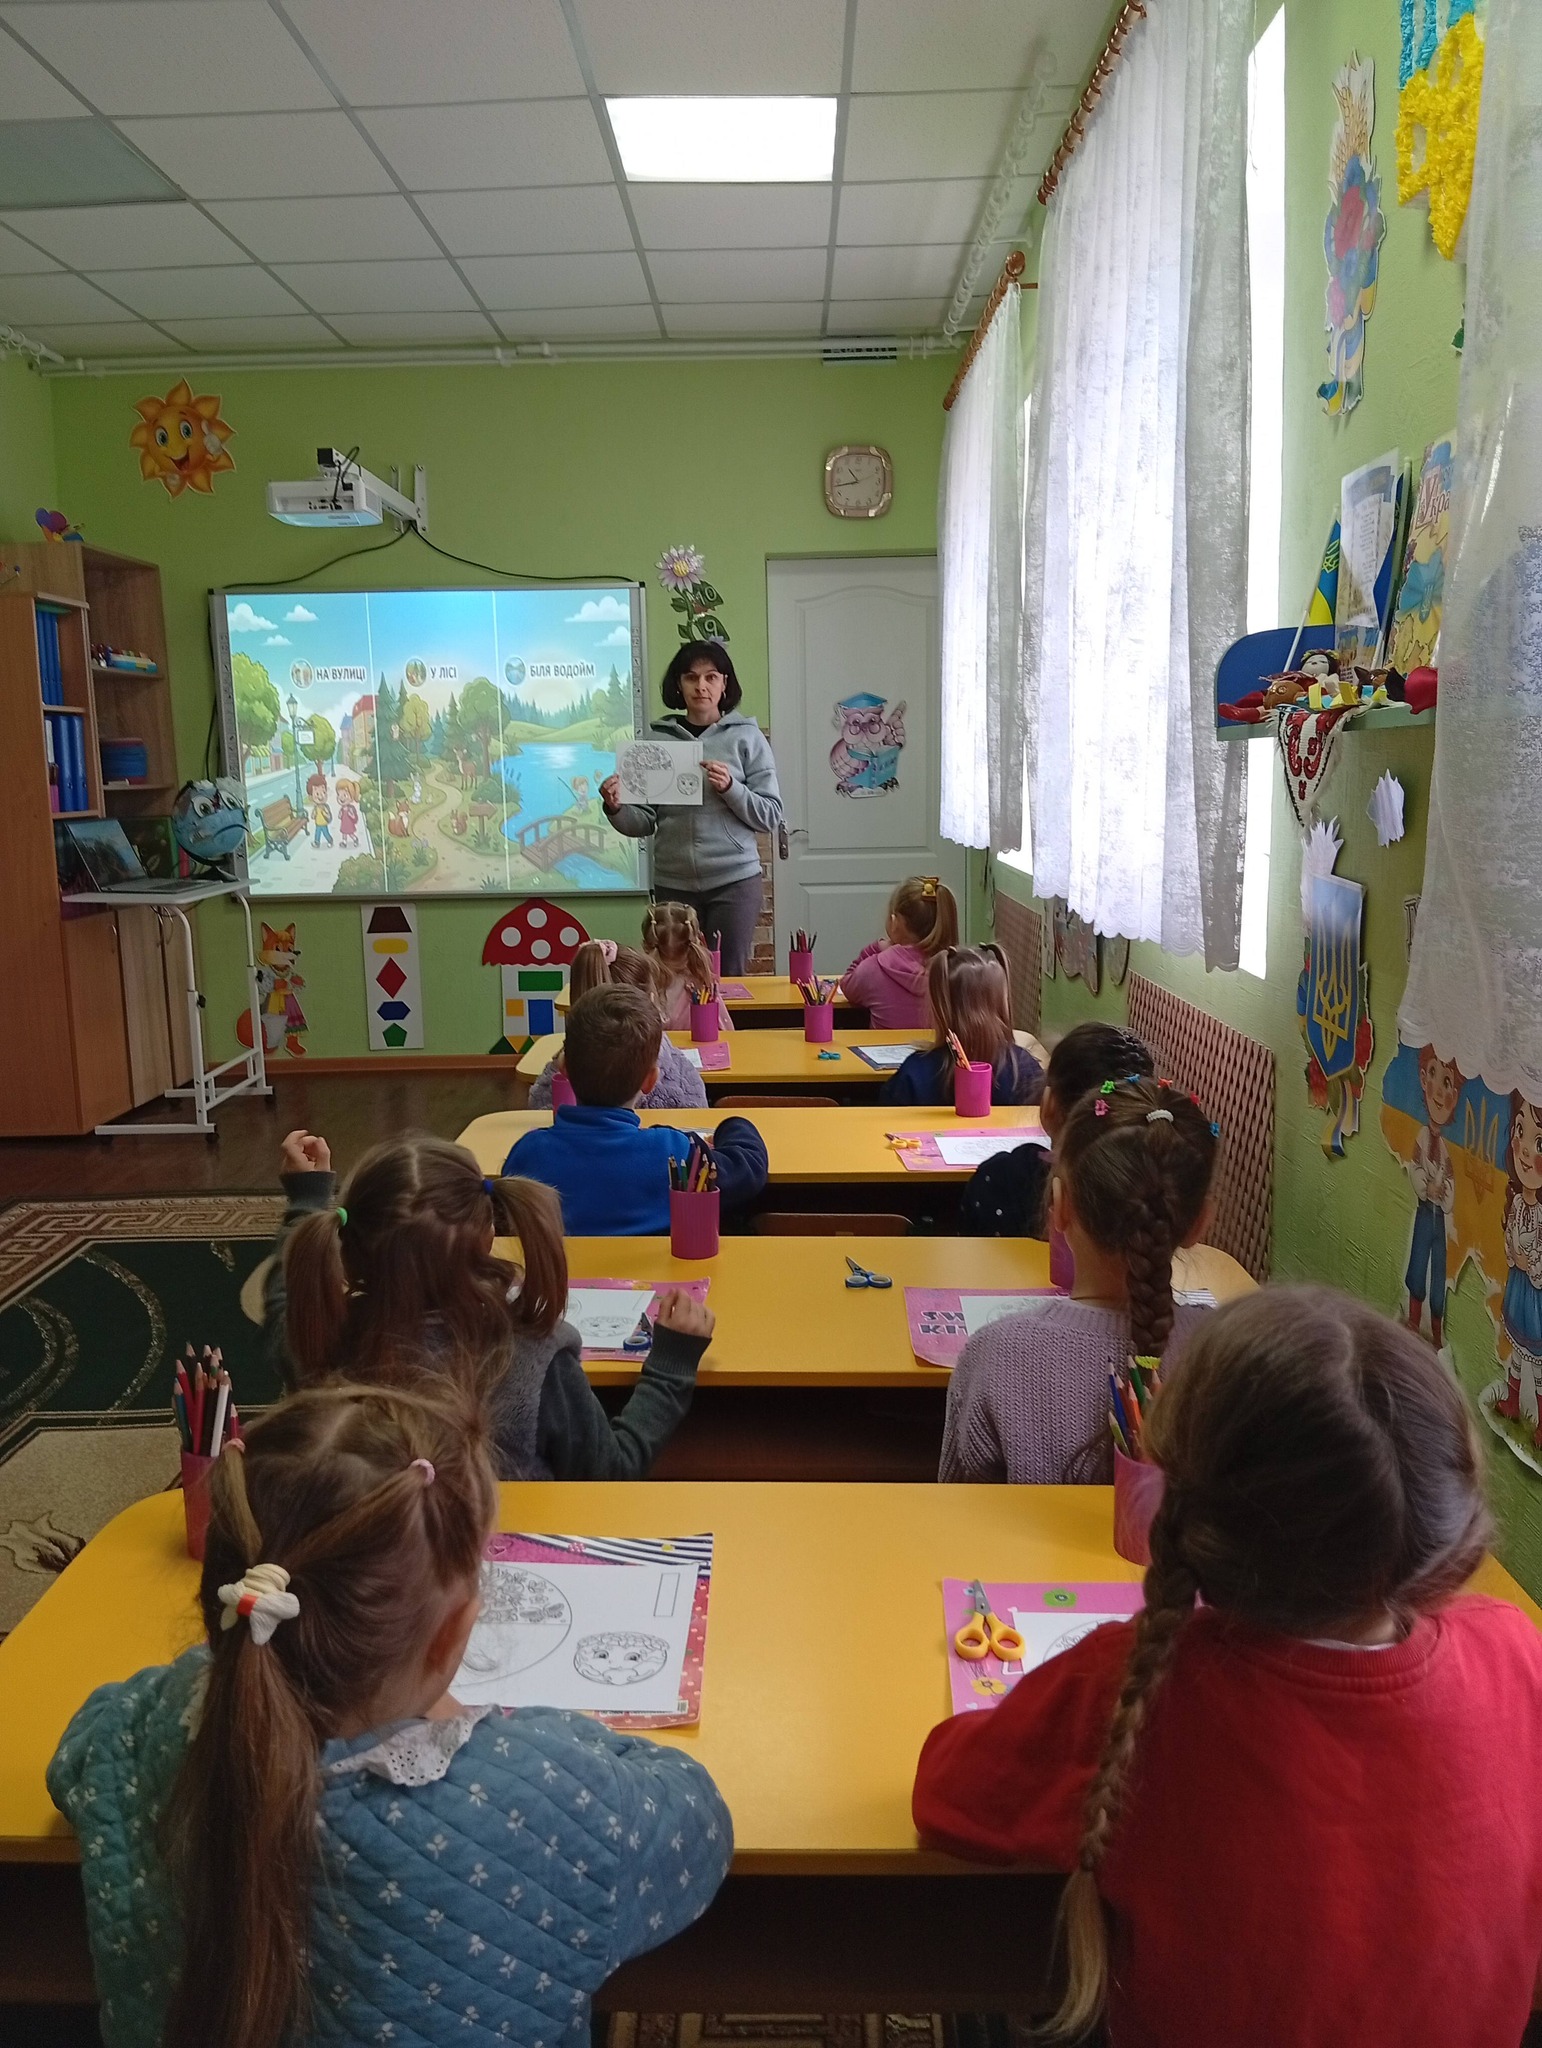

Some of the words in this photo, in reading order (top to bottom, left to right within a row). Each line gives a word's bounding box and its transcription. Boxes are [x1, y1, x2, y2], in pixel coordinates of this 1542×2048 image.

[696, 586, 717, 606] 10
[704, 619, 718, 637] 9
[316, 668, 330, 680] НА
[331, 668, 366, 682] ВУЛИЦІ
[430, 666, 437, 679] У
[439, 666, 457, 679] ЛІСІ
[530, 665, 551, 677] БІЛЯ
[553, 661, 594, 679] ВОДОЙМ
